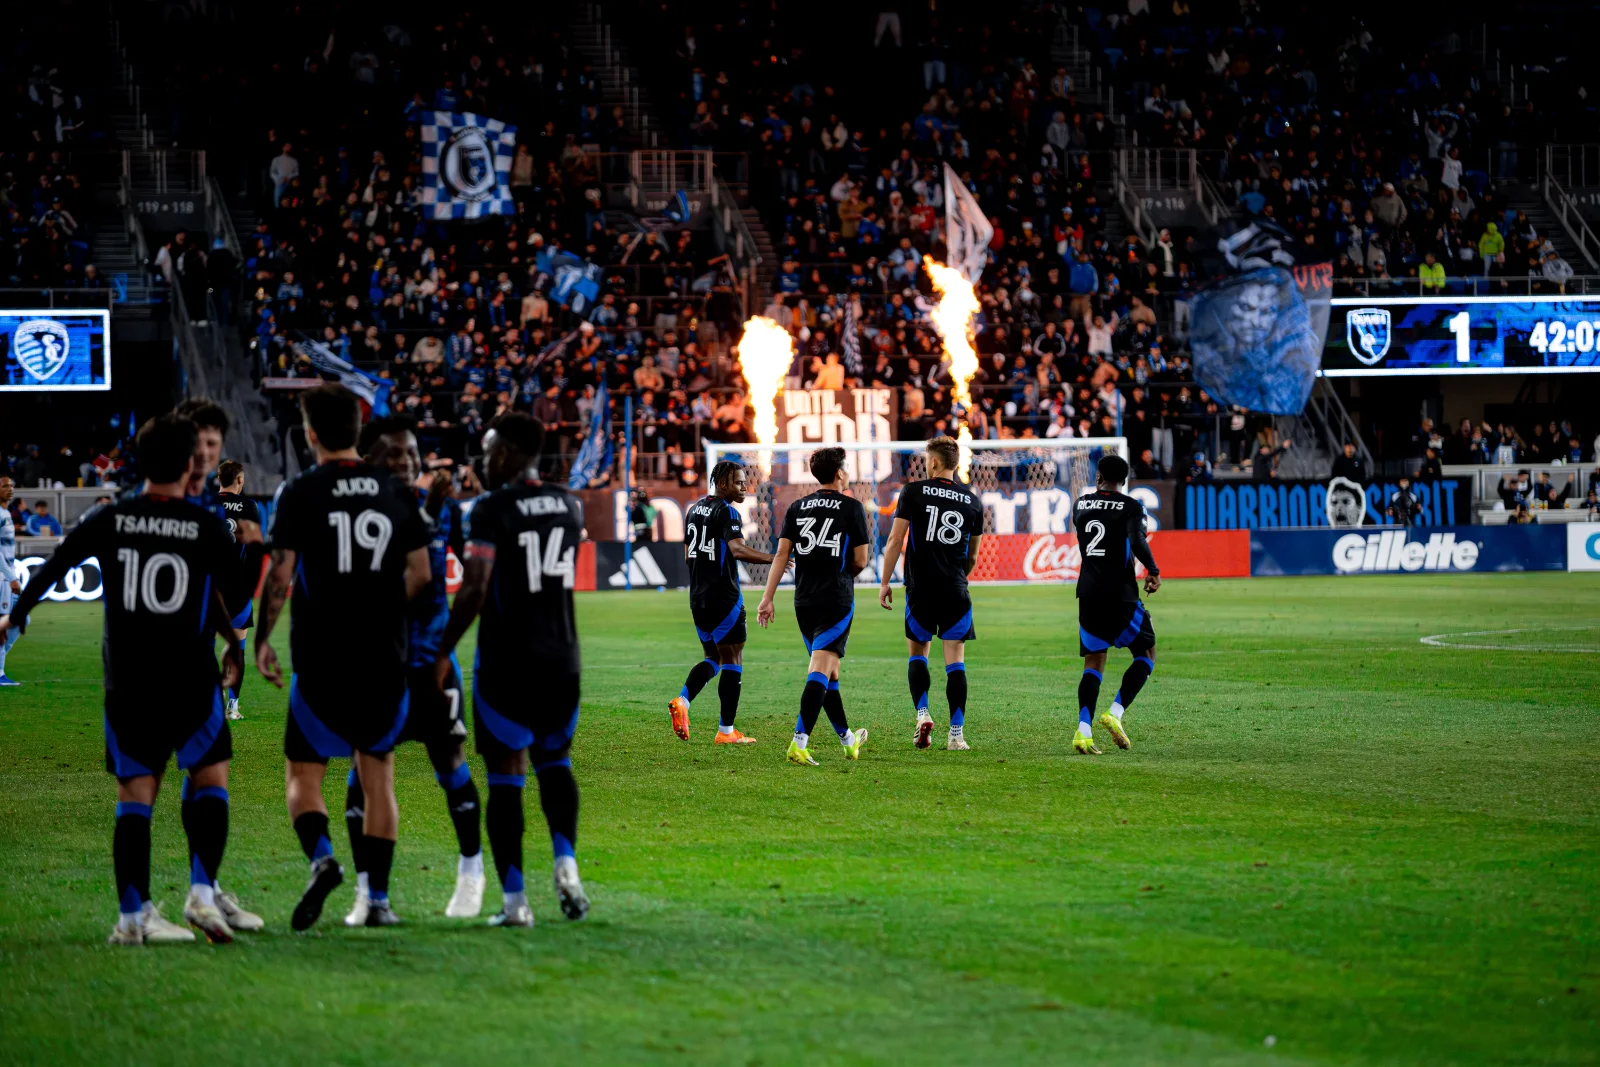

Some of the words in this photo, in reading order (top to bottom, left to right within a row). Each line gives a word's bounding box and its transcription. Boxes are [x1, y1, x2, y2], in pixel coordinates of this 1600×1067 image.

[1449, 311, 1470, 362] 1
[783, 389, 842, 417] UNTIL
[850, 388, 891, 415] THE
[331, 477, 380, 497] JUDD
[800, 498, 842, 511] LEROUX
[922, 485, 972, 505] ROBERTS
[1076, 499, 1125, 511] RICKETTS
[1365, 479, 1459, 527] SPRIT
[223, 501, 244, 512] OVIĆ
[692, 505, 713, 517] JONES
[925, 504, 965, 545] 18
[114, 513, 200, 540] TSAKIRIS
[328, 508, 393, 573] 19
[687, 523, 716, 561] 24
[795, 516, 842, 557] 34
[1084, 519, 1106, 557] 2
[518, 526, 576, 594] 14
[1331, 530, 1479, 571] Gillette
[117, 547, 189, 615] 10
